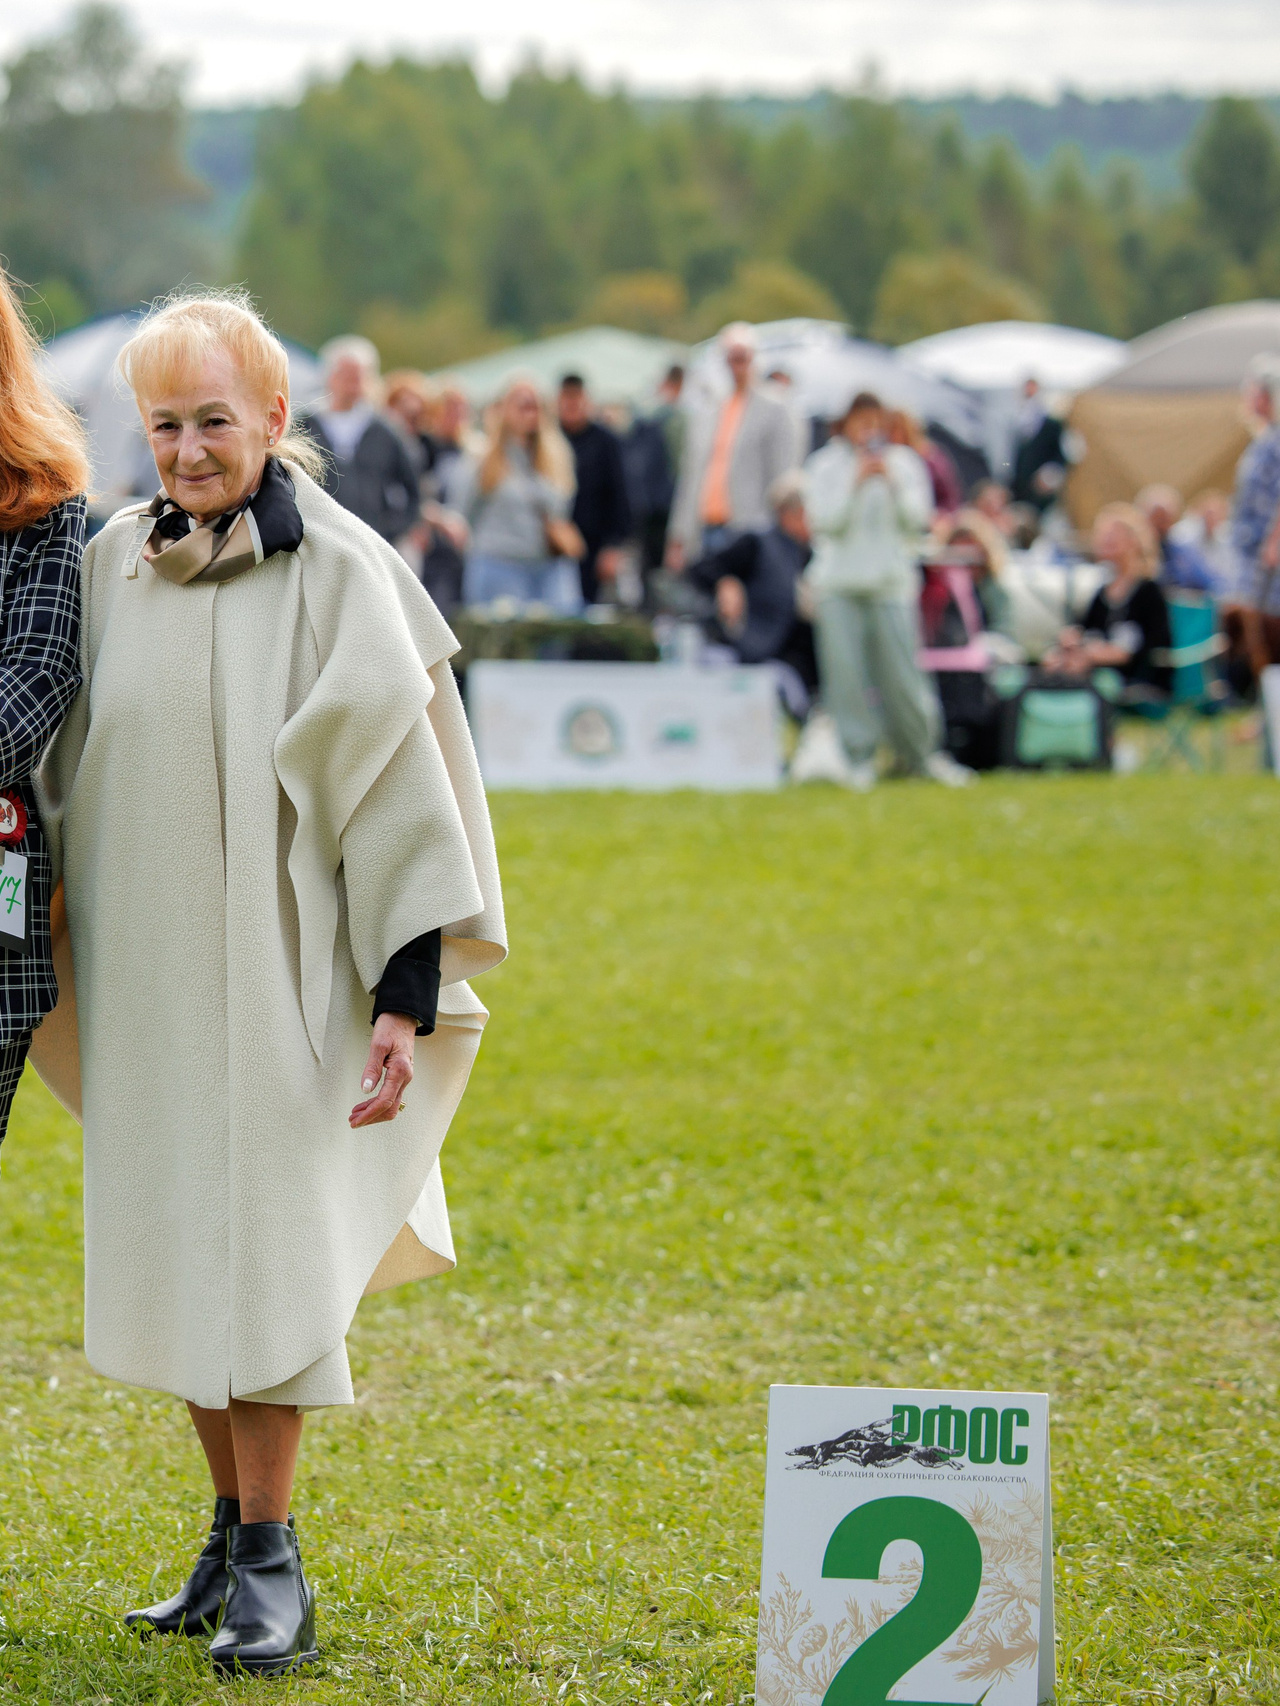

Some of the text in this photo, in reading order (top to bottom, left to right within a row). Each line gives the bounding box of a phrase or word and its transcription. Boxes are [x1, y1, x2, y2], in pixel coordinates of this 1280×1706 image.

[891, 1404, 1030, 1466] РФОС
[818, 1469, 1028, 1484] ФЕДЕРАЦИЯ ОХОТНИЧЬЕГО СОБАКОВОДСТВА
[820, 1495, 983, 1706] 2
